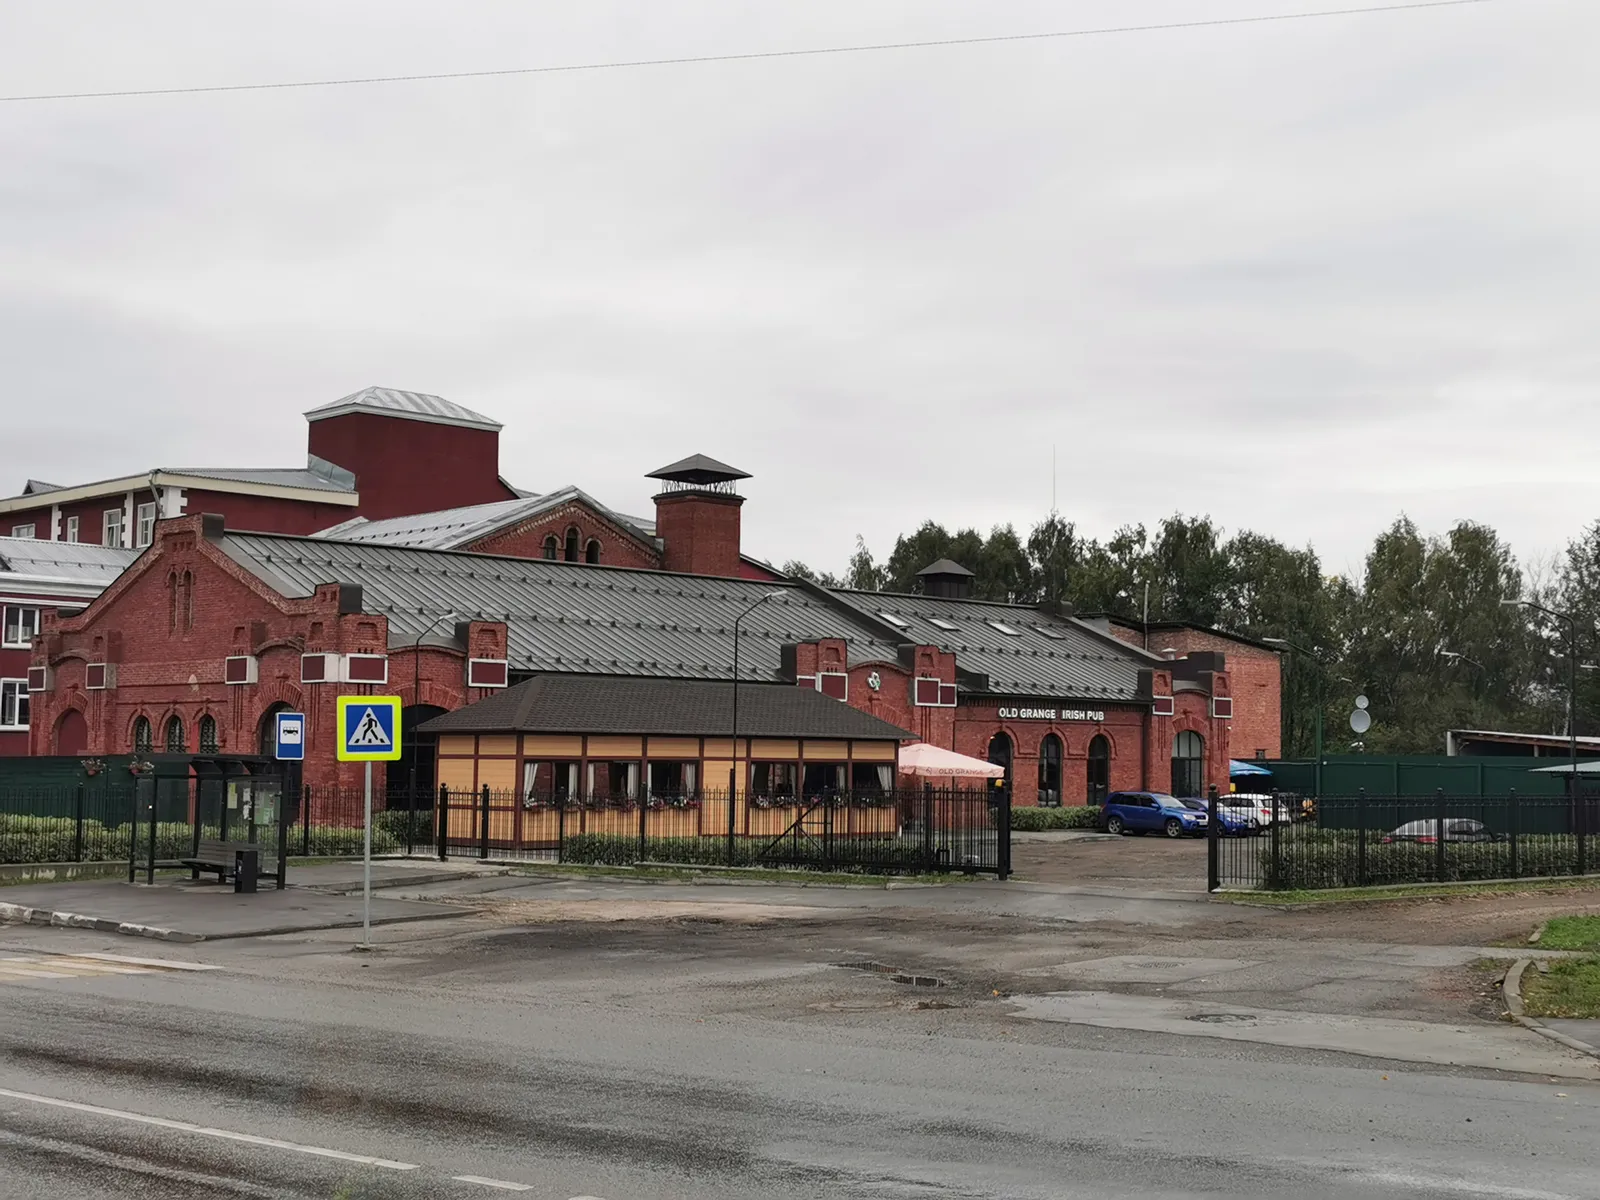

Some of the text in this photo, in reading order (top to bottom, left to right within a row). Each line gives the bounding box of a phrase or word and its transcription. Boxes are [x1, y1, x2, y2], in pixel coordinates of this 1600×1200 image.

[999, 707, 1105, 721] OLD GRANGE IRISH PUB
